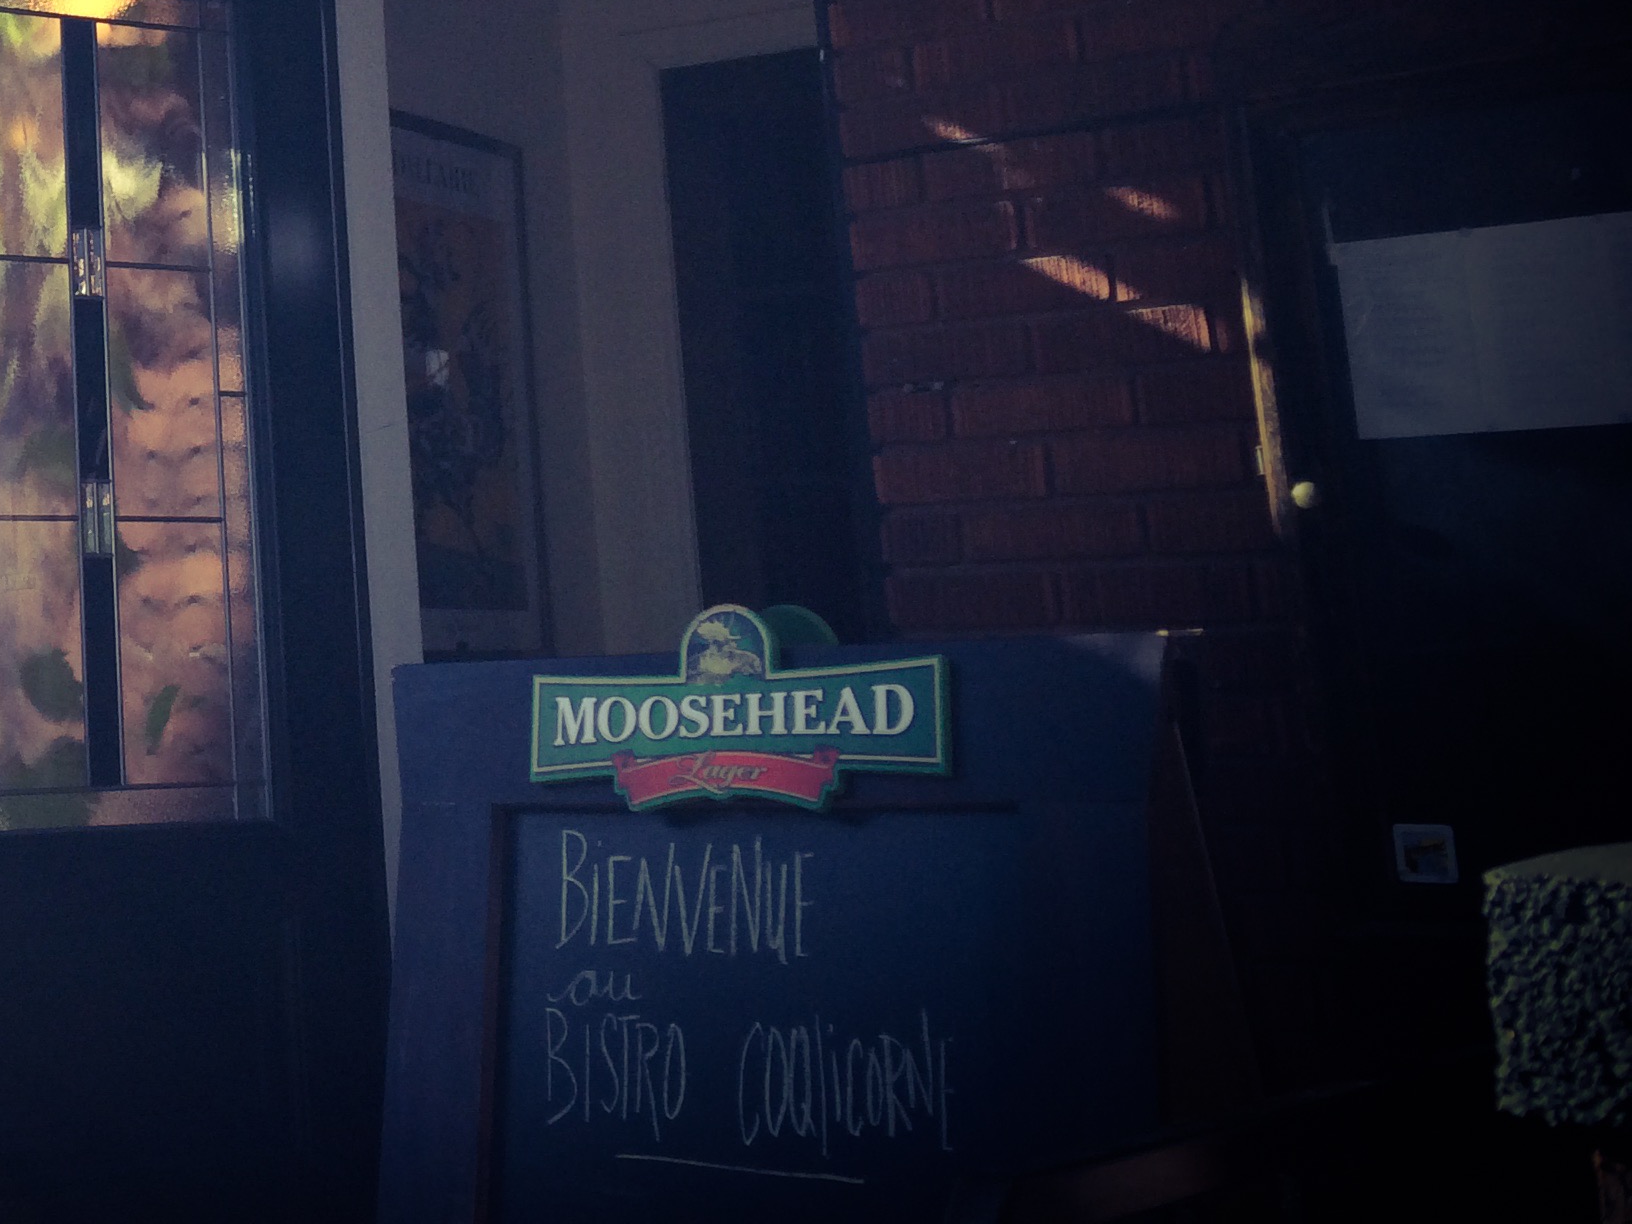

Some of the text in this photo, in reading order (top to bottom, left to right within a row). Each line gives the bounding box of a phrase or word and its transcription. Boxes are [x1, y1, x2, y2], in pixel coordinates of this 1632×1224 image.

[553, 683, 916, 747] MOOSEHEAD
[669, 750, 768, 795] Lager
[547, 970, 642, 1007] au
[545, 1007, 687, 1143] BISTRO
